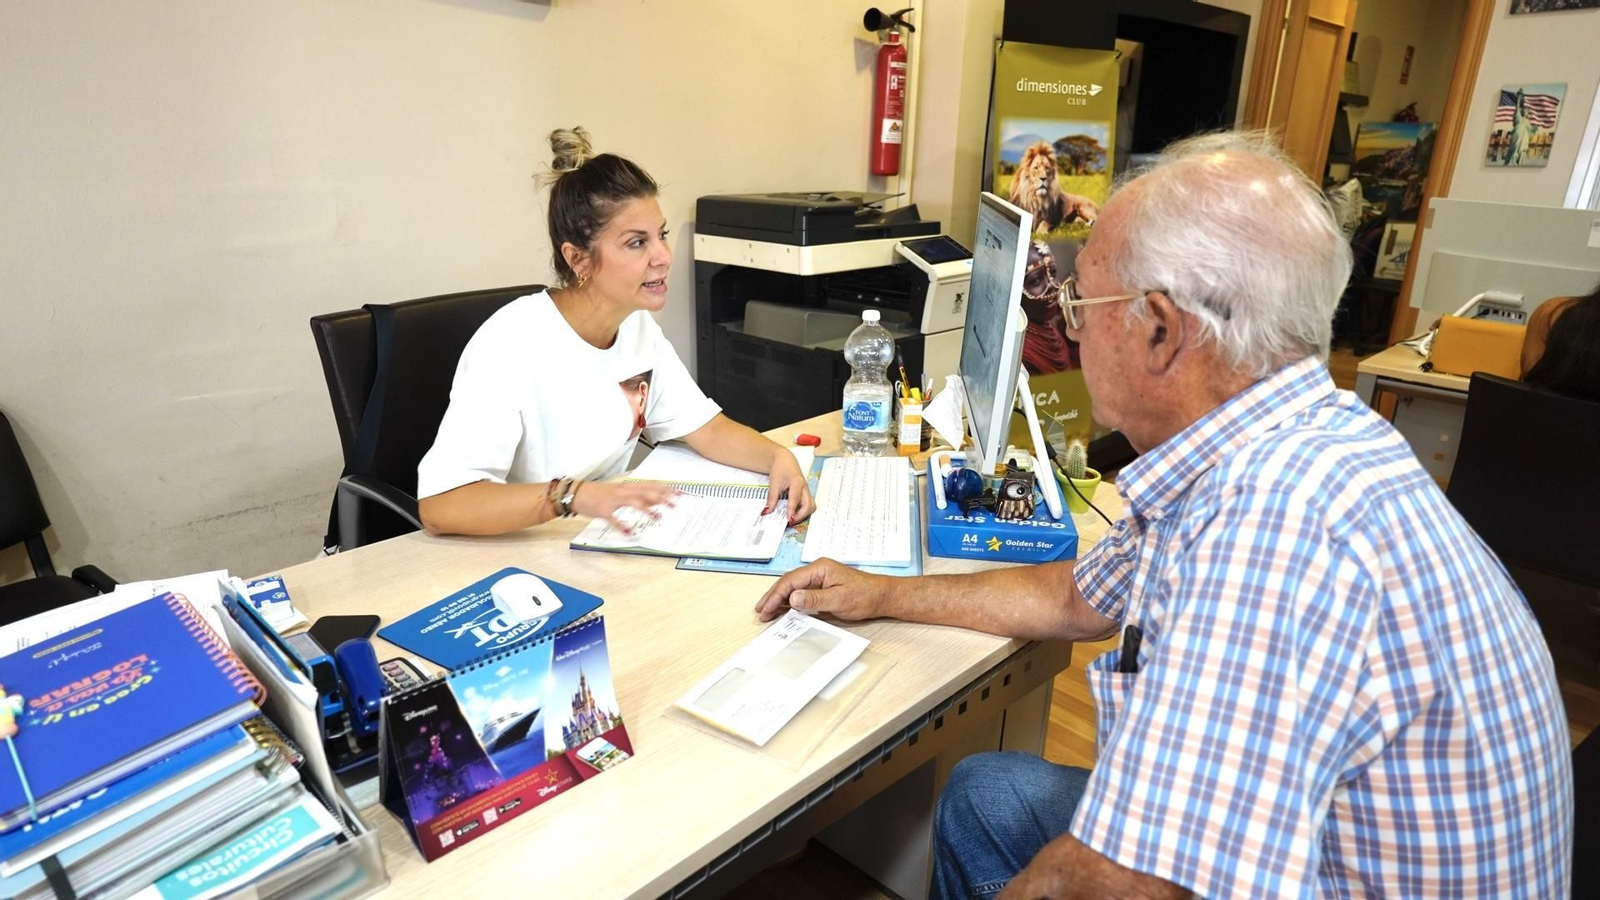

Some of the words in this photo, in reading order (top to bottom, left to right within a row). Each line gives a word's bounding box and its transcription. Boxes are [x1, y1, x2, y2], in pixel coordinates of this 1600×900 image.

[1016, 77, 1087, 96] dimensiones
[1067, 97, 1087, 106] CLUB
[848, 411, 875, 421] Natura
[944, 515, 987, 524] Star
[994, 516, 1066, 529] Golden
[962, 533, 978, 544] A4
[1005, 539, 1034, 547] Golden
[1036, 541, 1054, 549] Star
[448, 594, 493, 620] SOLIDADOR
[29, 653, 148, 708] LOGRAR
[66, 682, 109, 703] vas
[103, 675, 153, 705] Cree
[44, 701, 63, 713] a
[69, 703, 100, 718] en
[175, 817, 292, 881] Culturales
[188, 829, 294, 888] Circuitos
